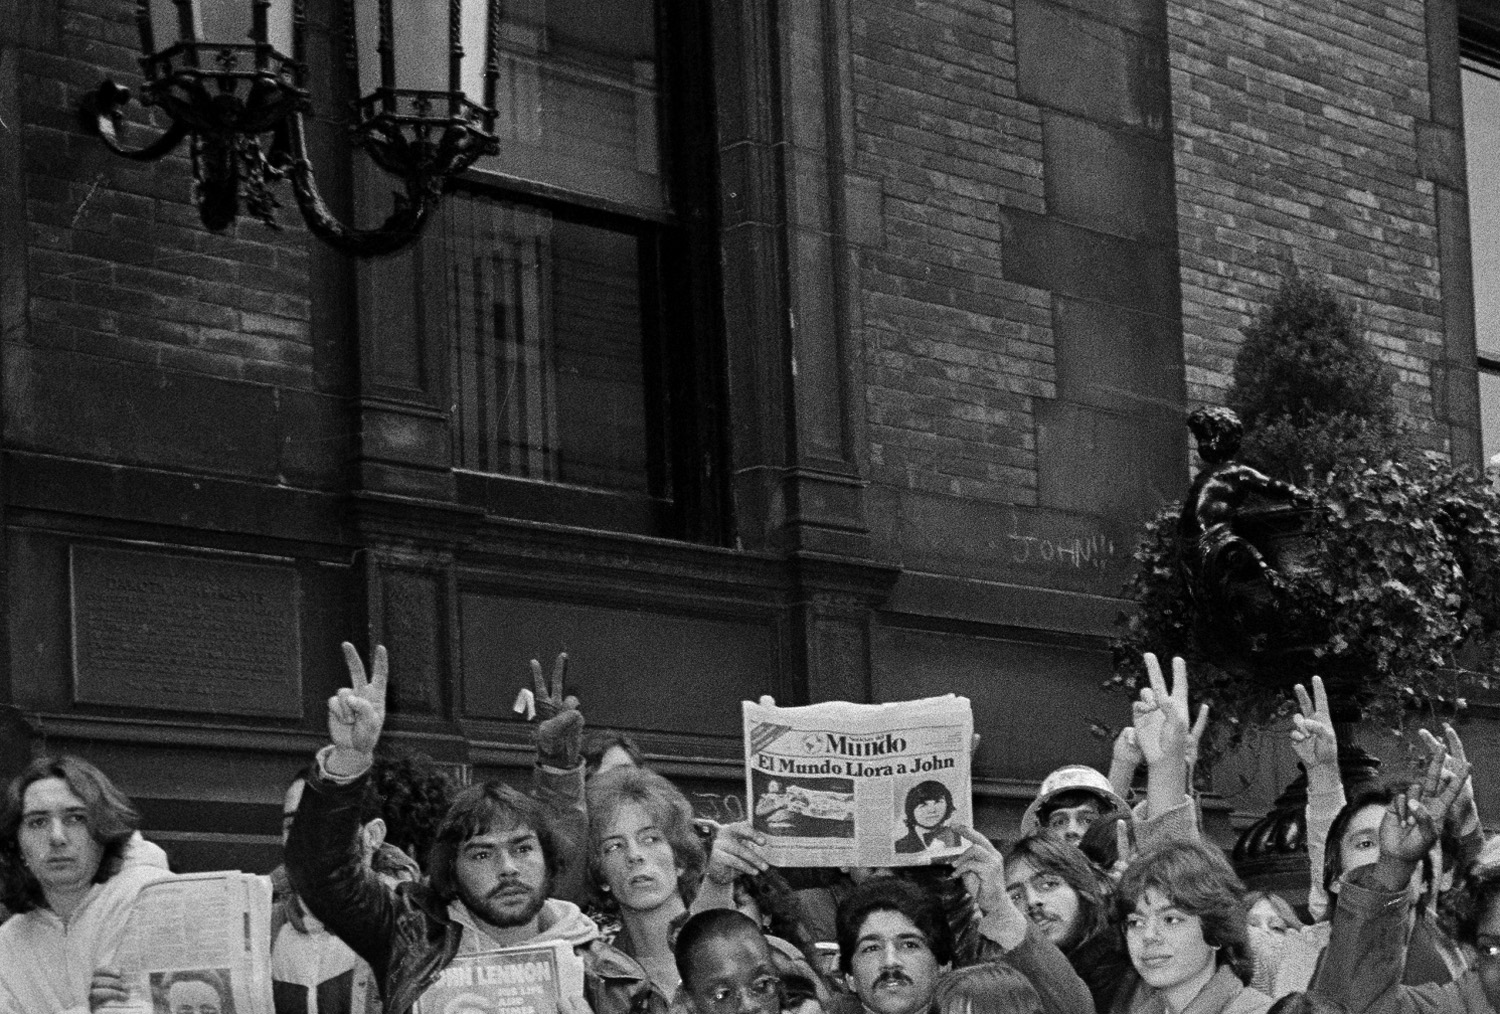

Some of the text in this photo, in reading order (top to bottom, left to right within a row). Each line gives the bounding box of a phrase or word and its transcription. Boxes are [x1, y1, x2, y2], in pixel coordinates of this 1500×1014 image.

[826, 733, 907, 757] Mundo
[758, 753, 955, 777] El Mundo Llora a John
[477, 961, 551, 986] LENNON
